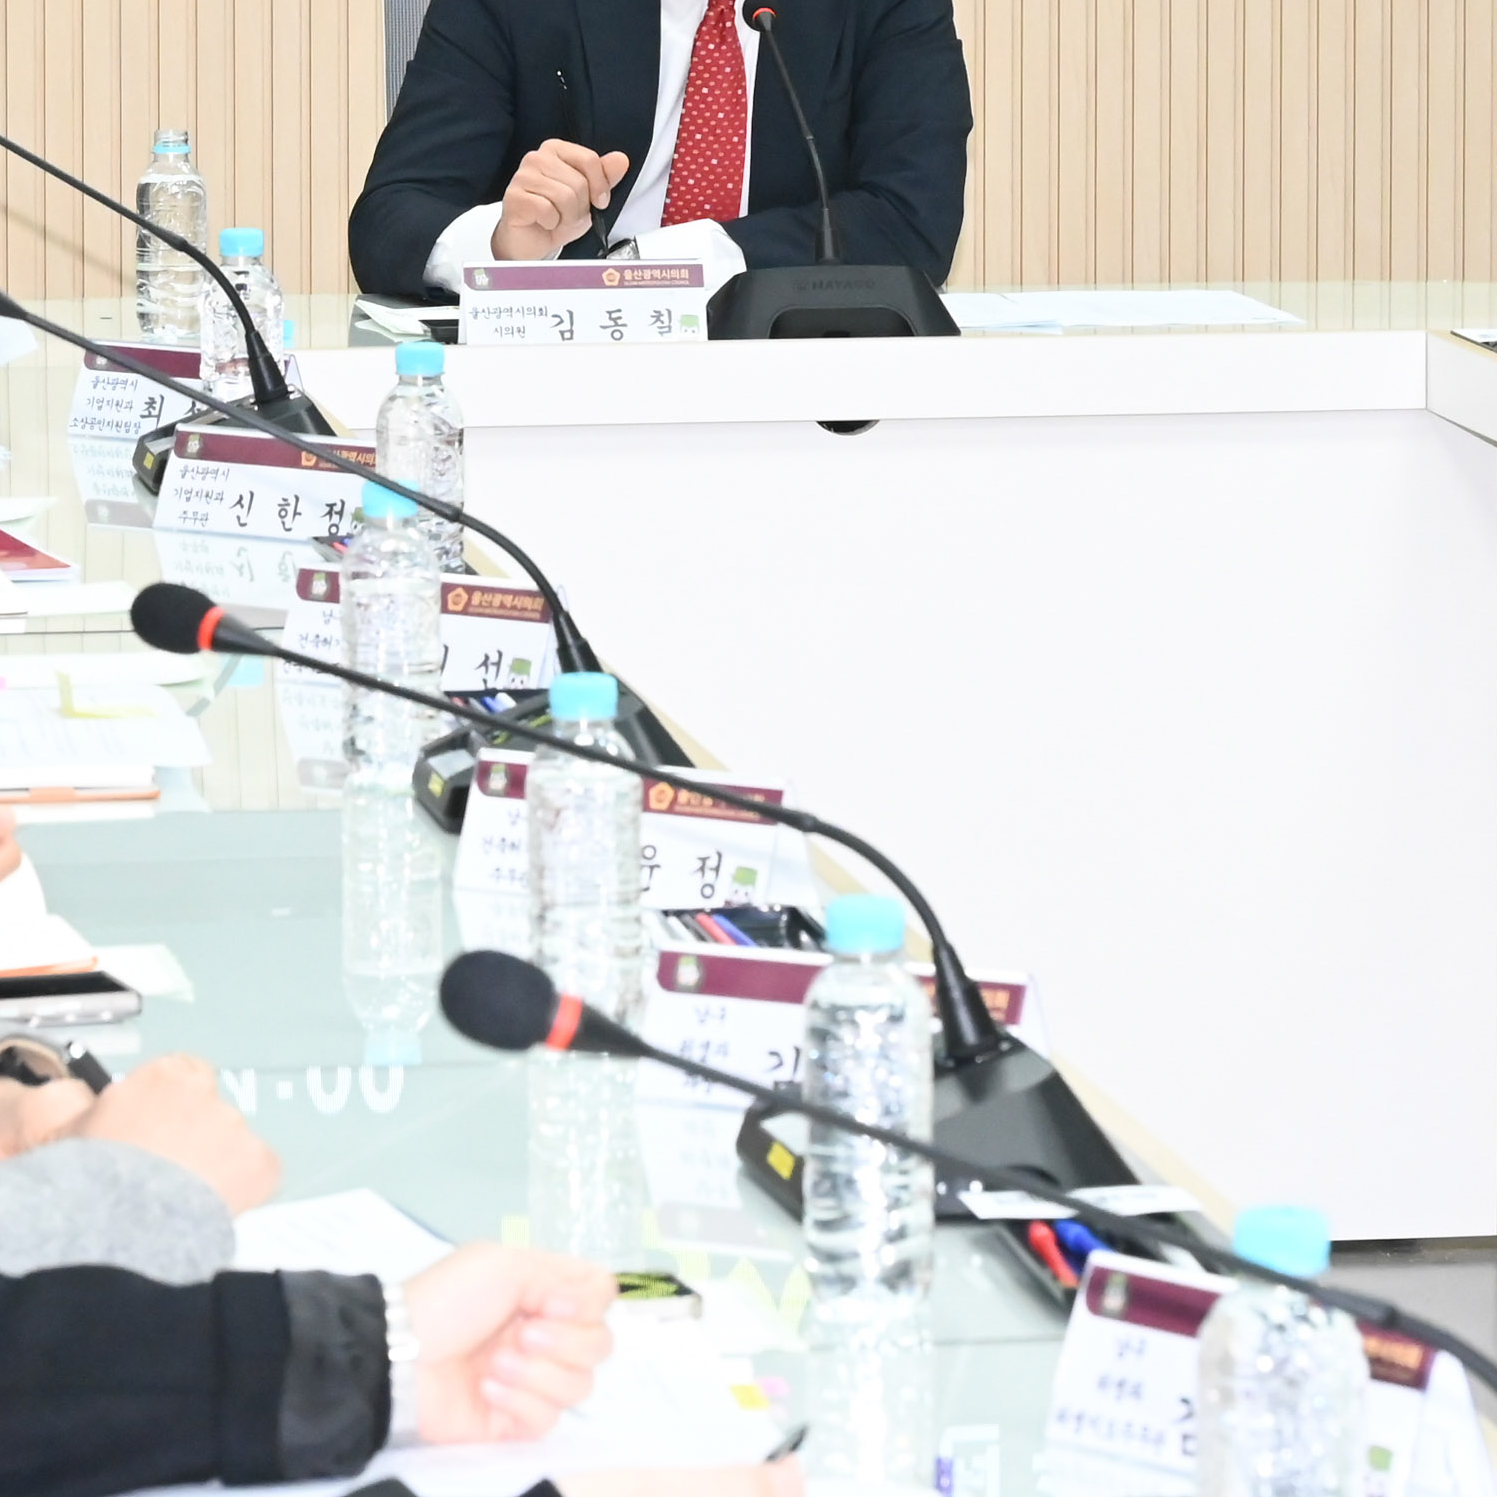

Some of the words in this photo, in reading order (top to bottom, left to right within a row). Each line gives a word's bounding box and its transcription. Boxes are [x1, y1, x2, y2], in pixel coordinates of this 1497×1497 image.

[624, 268, 690, 281] 울산광역시의회
[468, 306, 548, 320] 울산광역시의회
[494, 325, 526, 339] 시의원
[91, 375, 138, 392] 울산광역시
[87, 396, 134, 412] 기업지원과
[69, 416, 142, 434] 소상공인지원팀장
[179, 461, 231, 482] 울산광역시
[174, 487, 224, 505] 기업지원과
